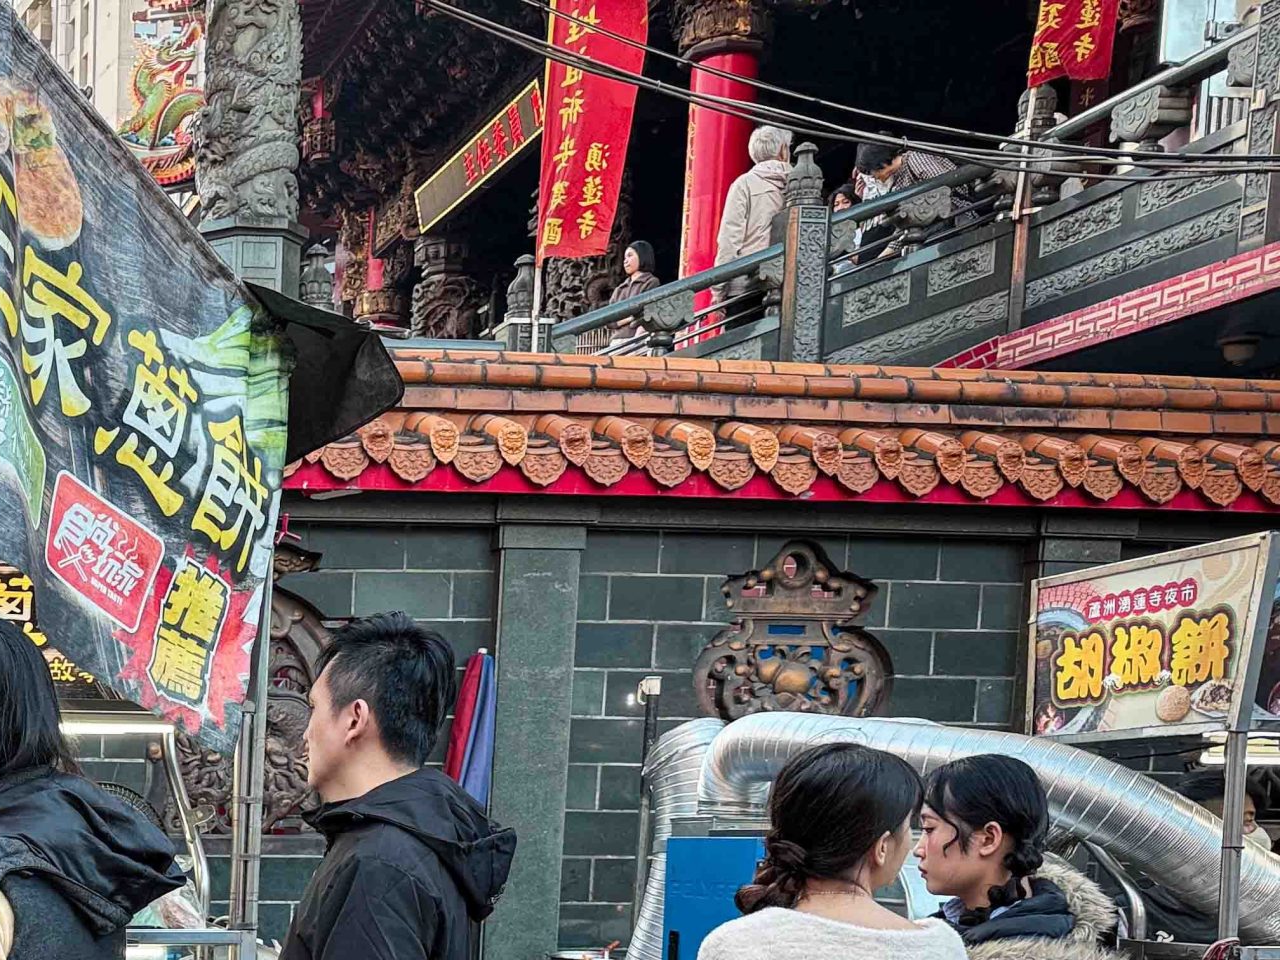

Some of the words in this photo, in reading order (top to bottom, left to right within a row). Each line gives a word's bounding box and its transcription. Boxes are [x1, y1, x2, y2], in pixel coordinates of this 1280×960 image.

[151, 562, 226, 702] 推薦
[1088, 585, 1197, 619] 蘆洲湧蓮寺夜市
[49, 658, 95, 684] 故
[1056, 613, 1230, 700] 胡椒餅
